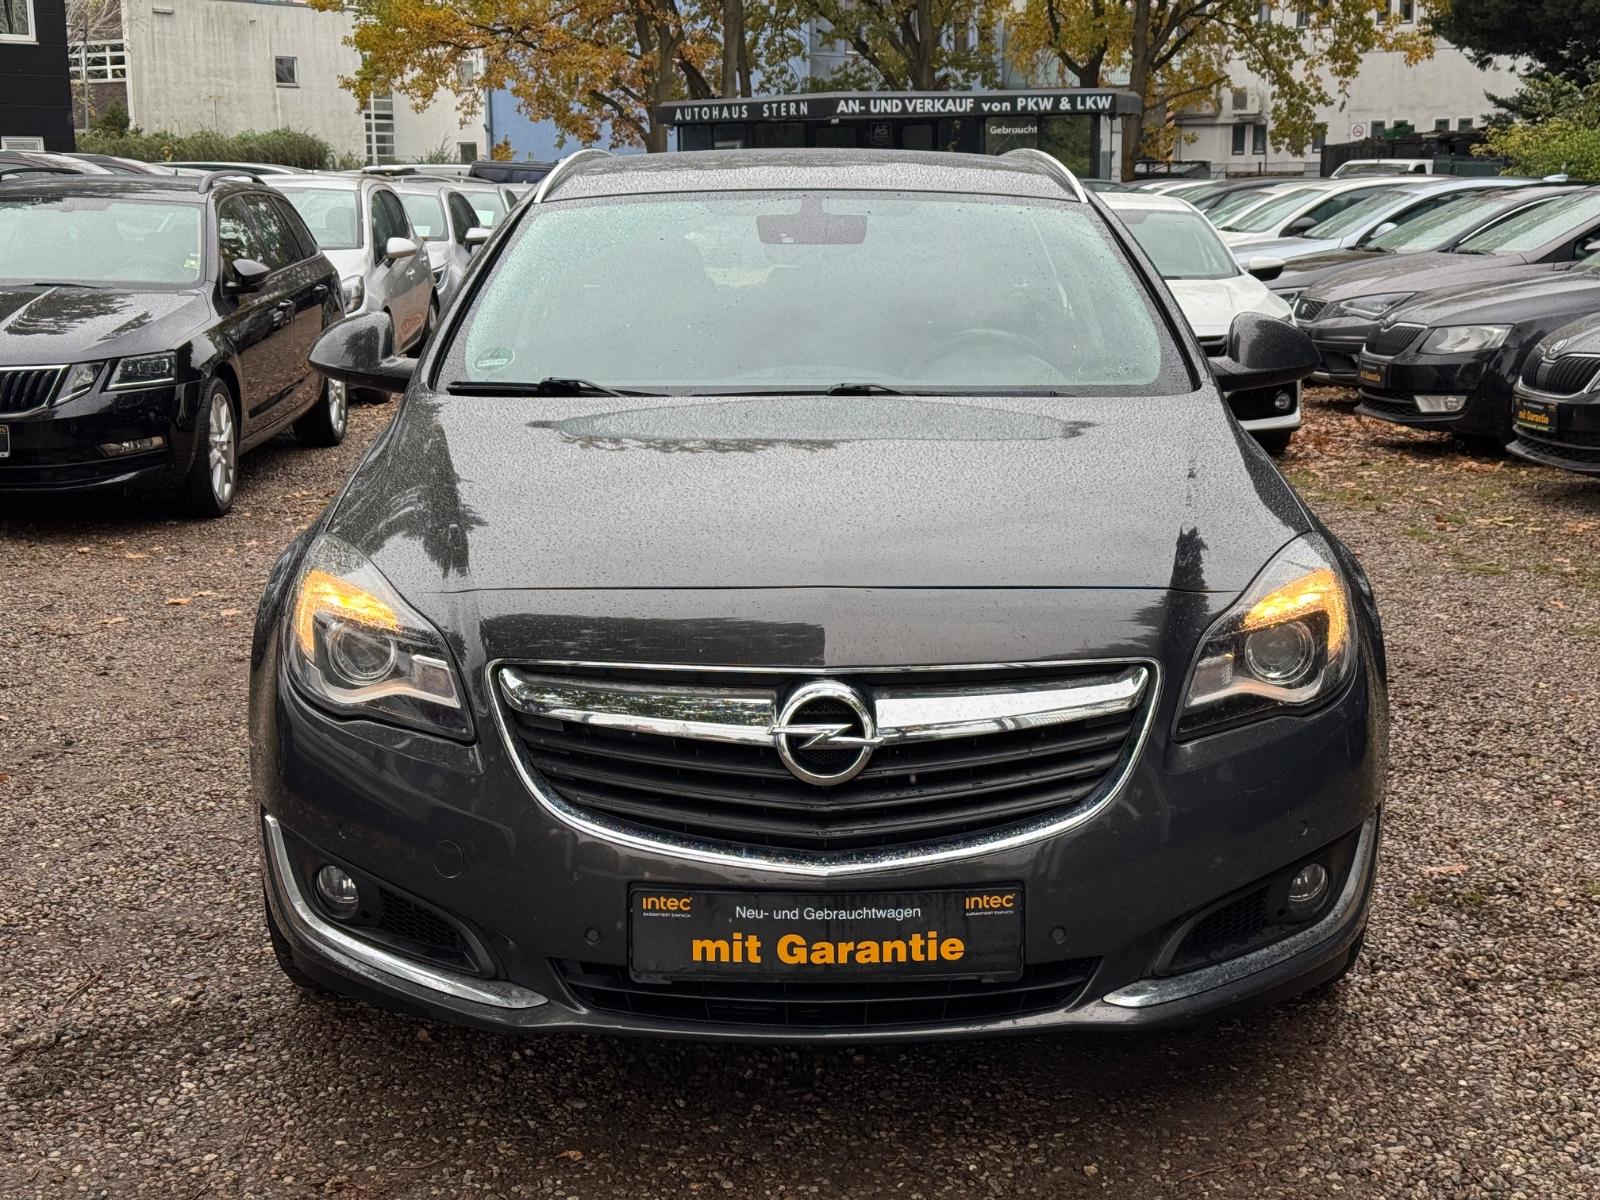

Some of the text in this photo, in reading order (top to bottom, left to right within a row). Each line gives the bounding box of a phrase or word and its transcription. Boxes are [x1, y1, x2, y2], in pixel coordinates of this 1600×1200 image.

[675, 102, 808, 121] AUTOHAUS STERN
[836, 95, 1112, 114] AN- UND VERKAUF von PKW & LKW
[990, 125, 1038, 134] Gebraucht
[642, 896, 691, 911] intec
[965, 894, 1014, 909] intec
[735, 906, 921, 921] Neu- und Gebrauchtwagen
[692, 930, 965, 965] mit Garantie
